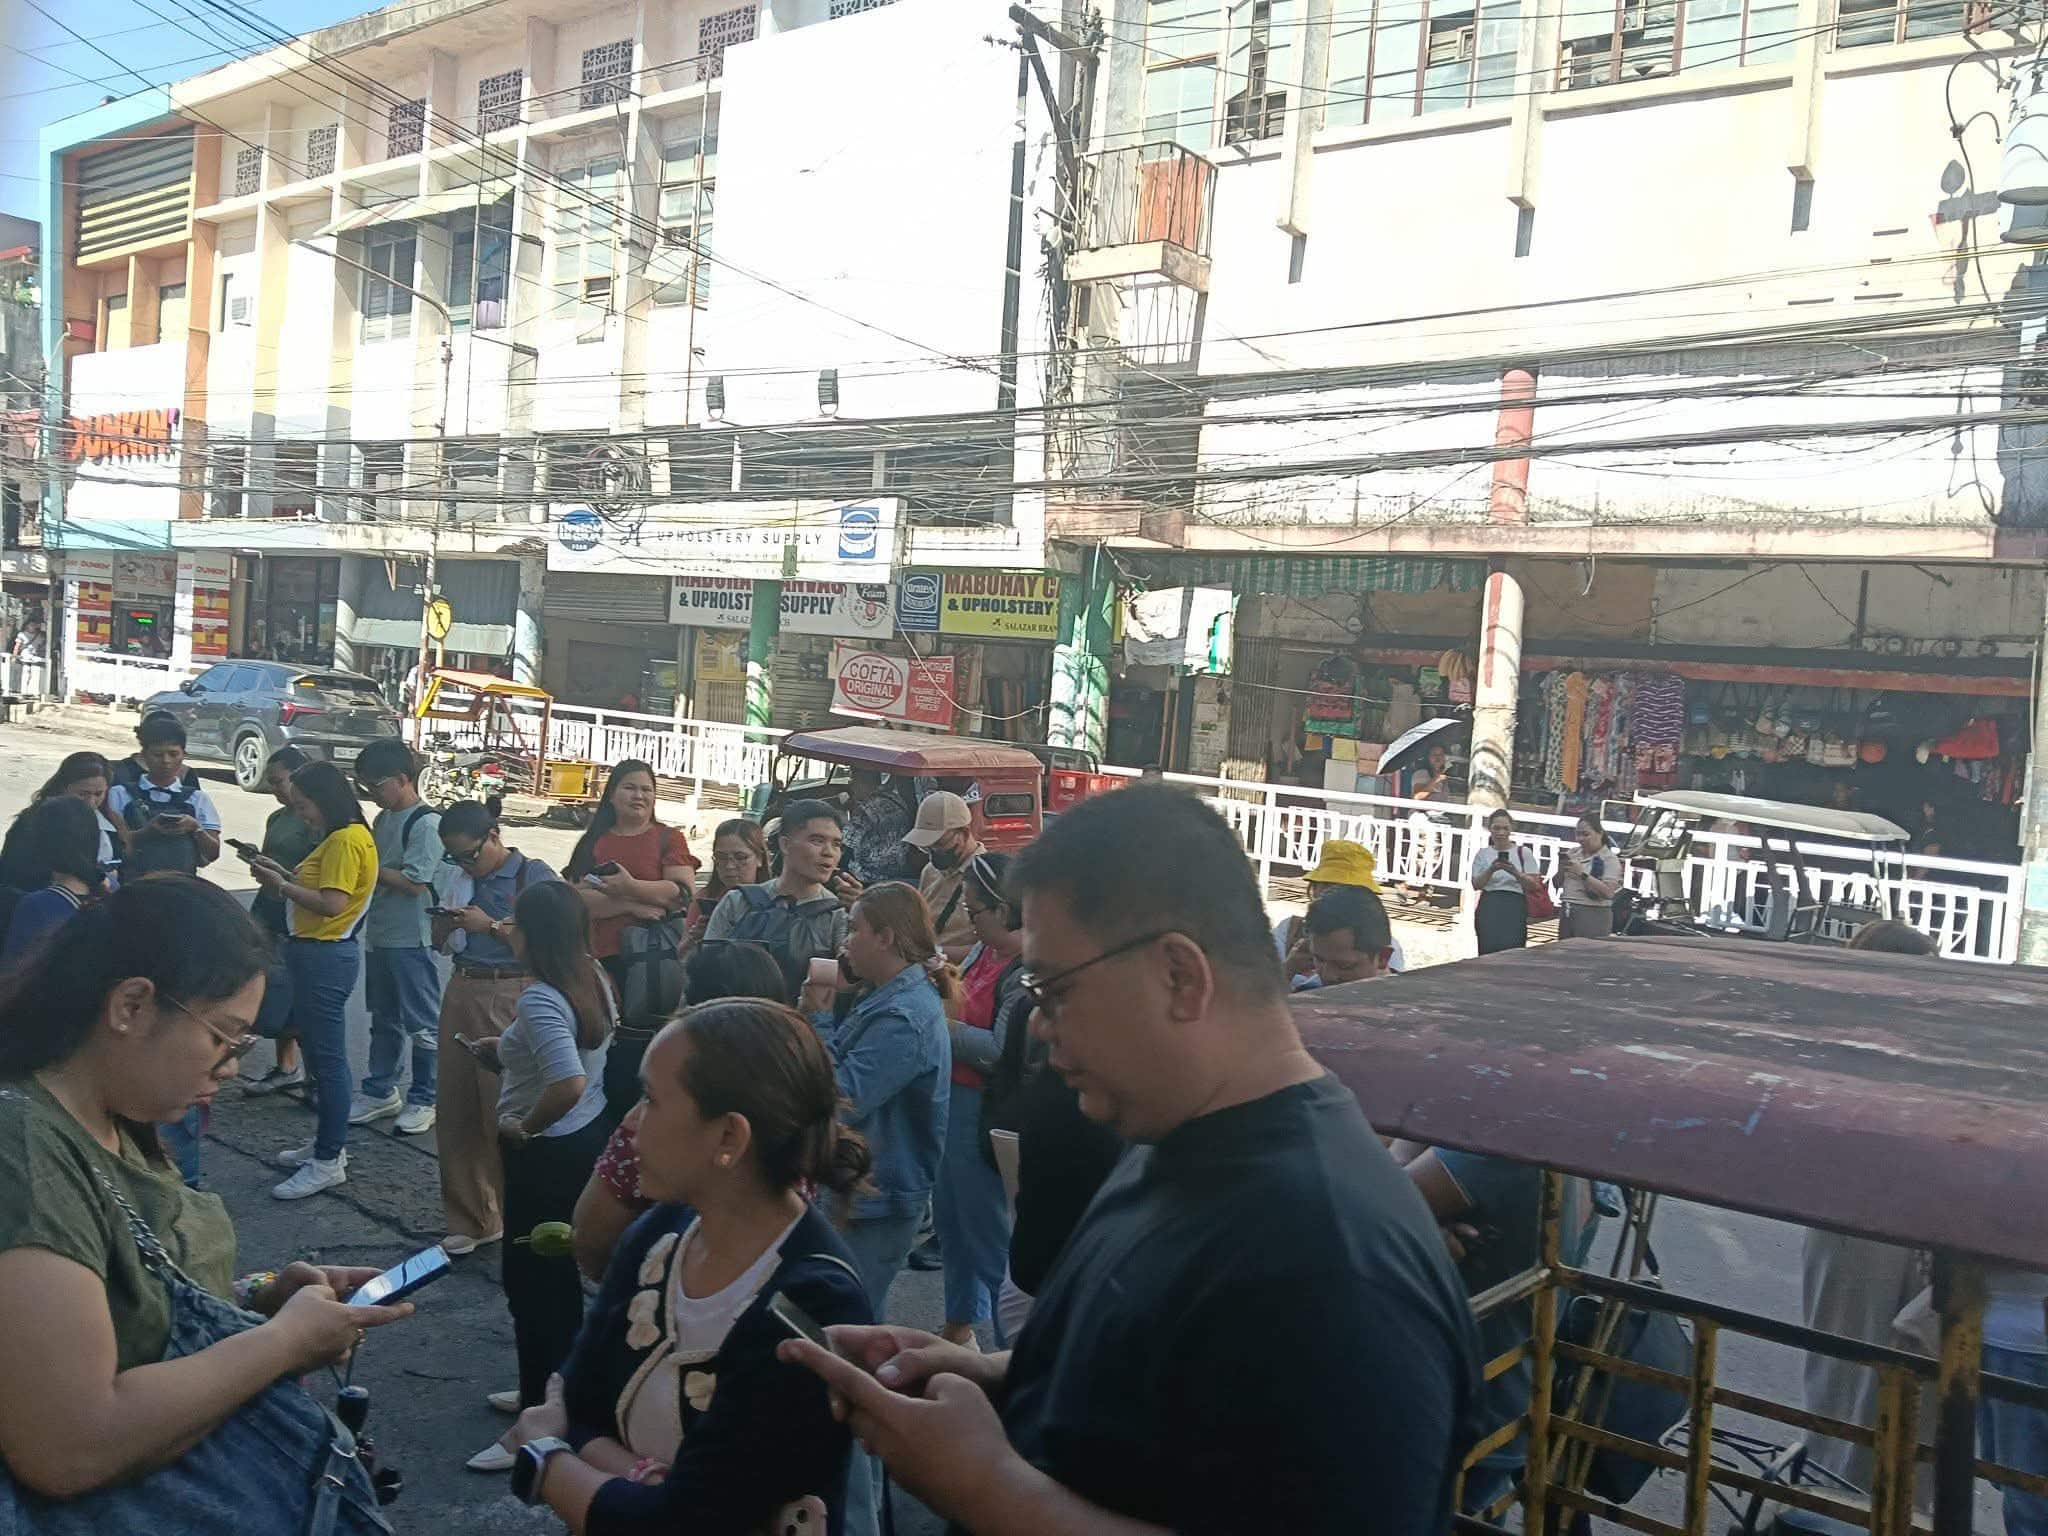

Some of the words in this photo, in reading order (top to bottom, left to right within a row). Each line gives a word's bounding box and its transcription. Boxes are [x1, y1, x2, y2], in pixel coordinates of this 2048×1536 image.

[657, 530, 752, 544] UPHOLSTERY
[762, 533, 823, 545] SUPPLY
[674, 576, 753, 590] MABUHA
[944, 574, 1039, 598] MABUHAY
[679, 592, 689, 607] &
[691, 590, 753, 611] UPHOLST
[780, 594, 835, 615] SUPPLY
[947, 598, 959, 611] &
[962, 597, 1054, 616] UPHOLSTERY
[1004, 622, 1037, 632] SALAZAR
[1038, 625, 1058, 633] BRAN
[849, 662, 895, 684] COFTA
[846, 680, 895, 698] ORIGINAL
